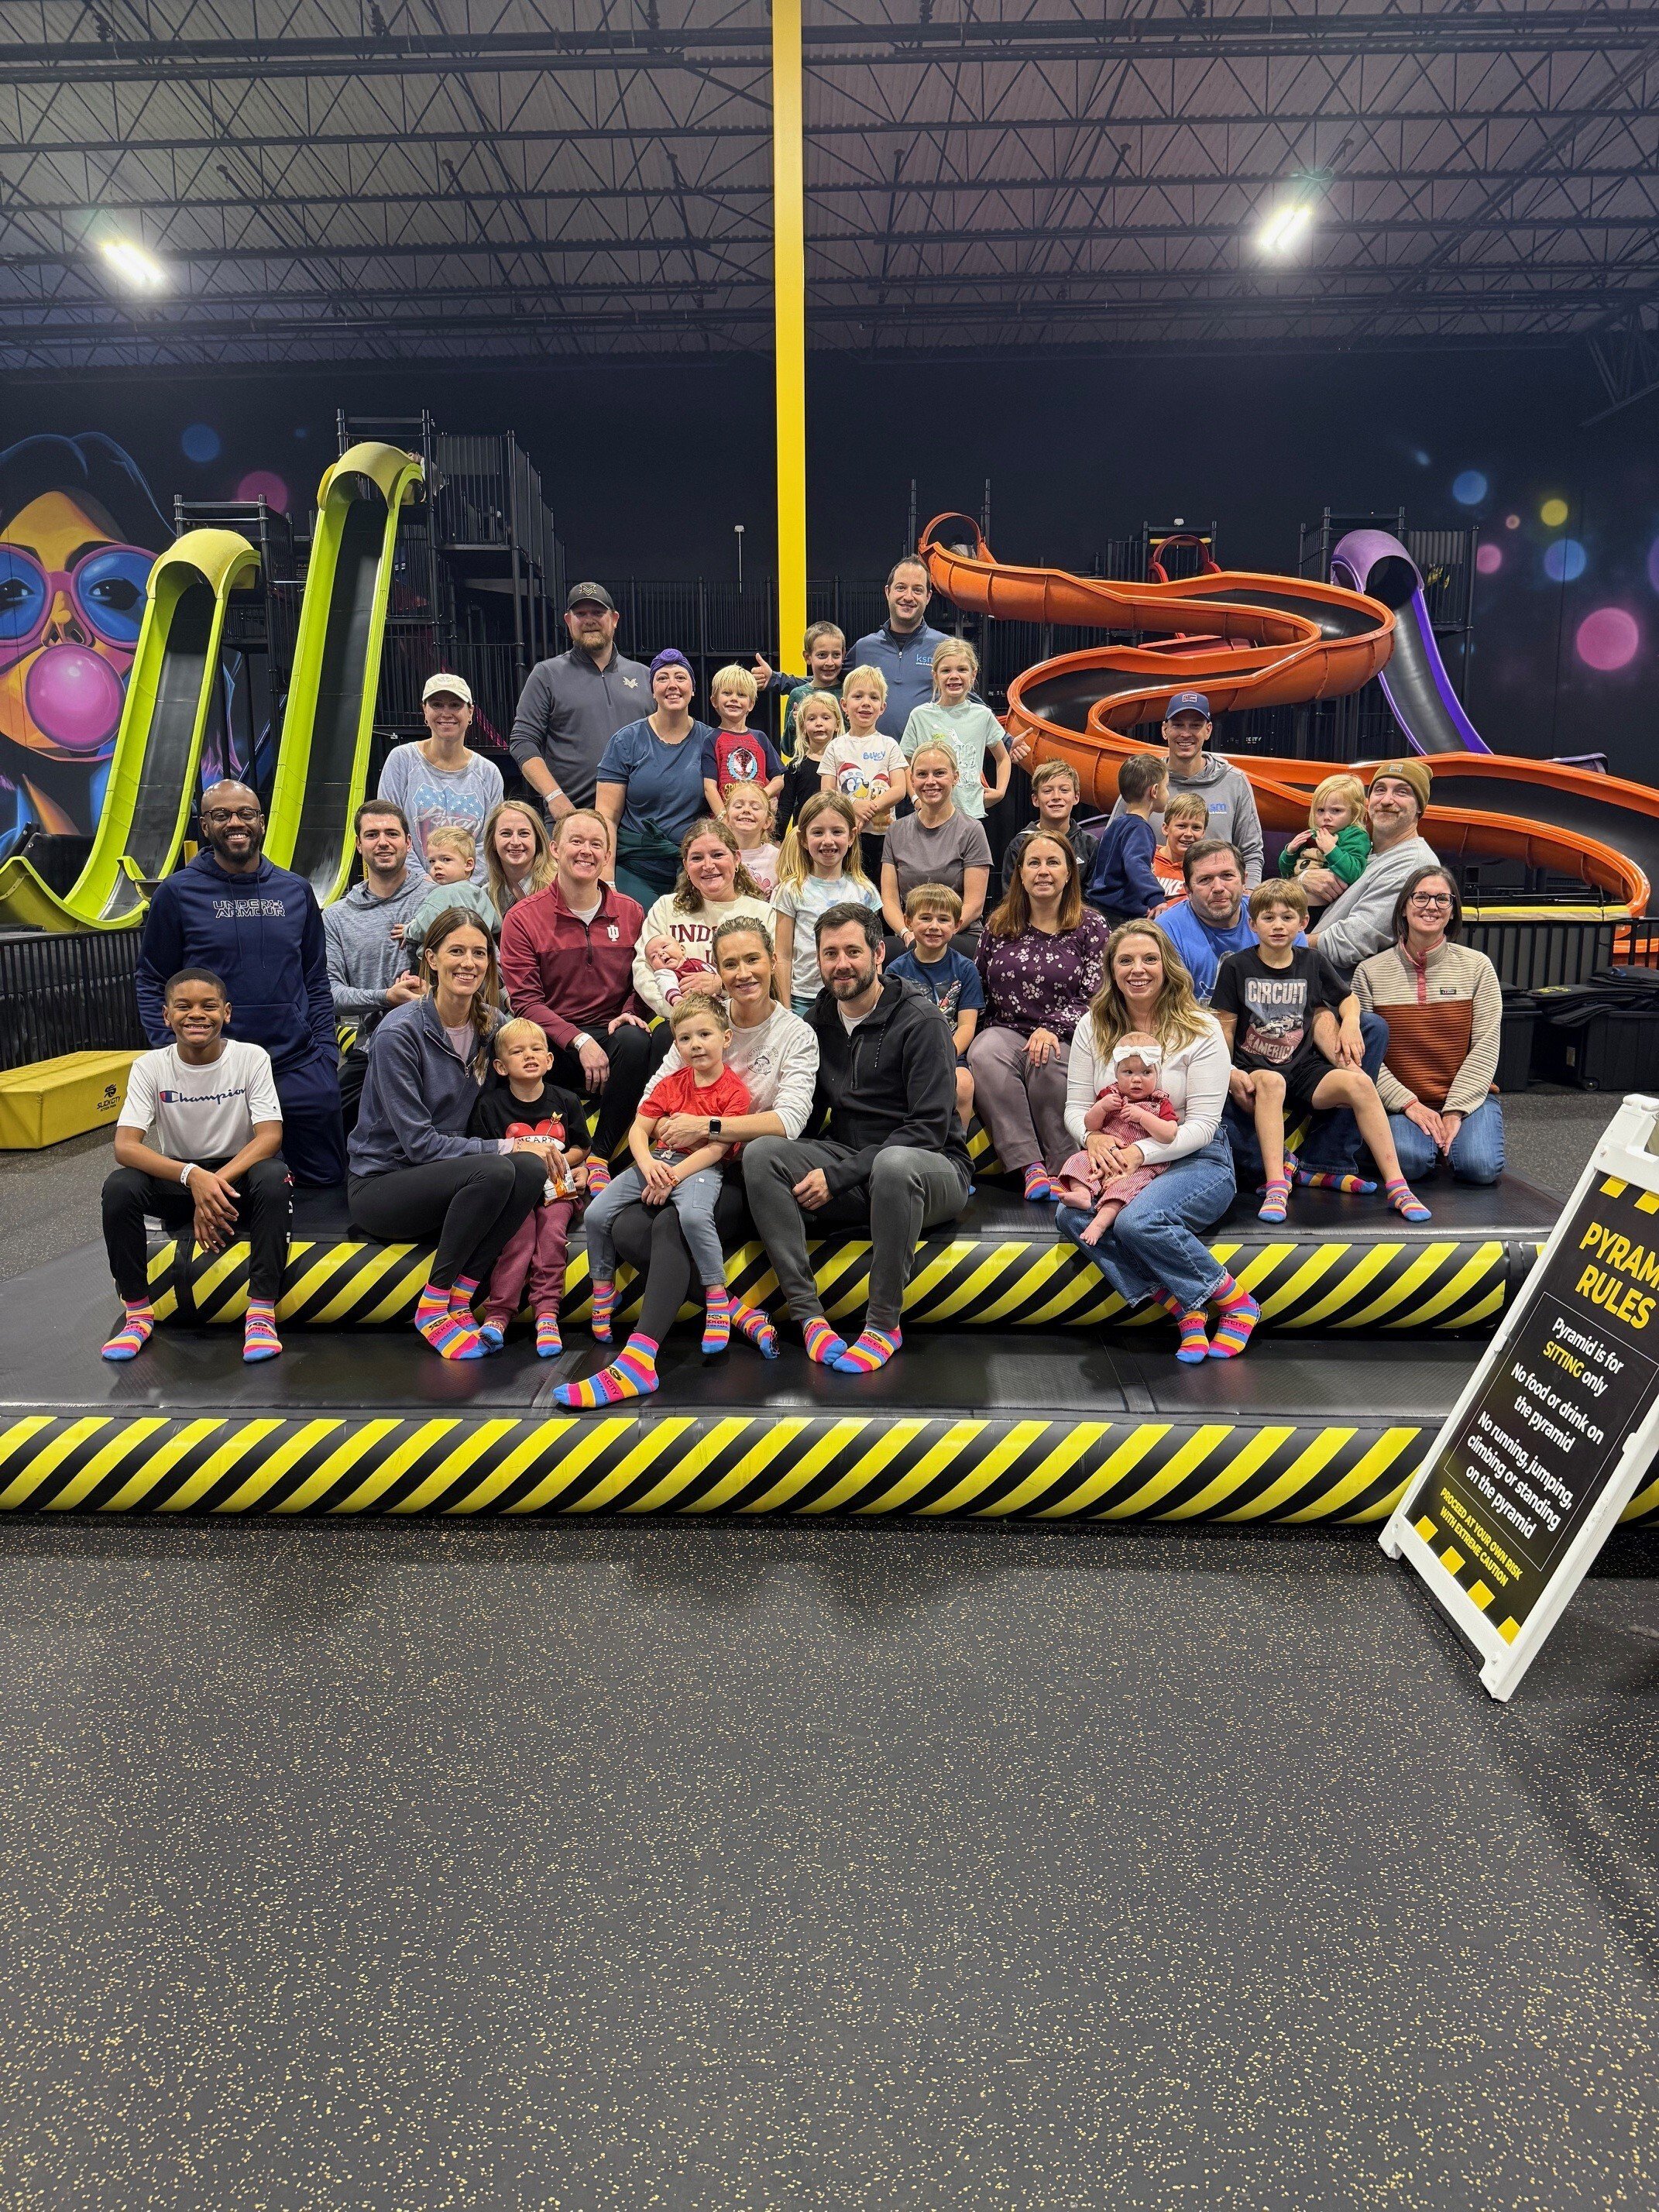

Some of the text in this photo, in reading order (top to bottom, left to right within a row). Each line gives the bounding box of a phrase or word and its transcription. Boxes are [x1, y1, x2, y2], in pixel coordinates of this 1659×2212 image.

[213, 899, 269, 909] UNDER
[216, 908, 285, 918] ARMOUR
[669, 924, 717, 943] IND
[1248, 981, 1306, 1005] CIRCUIT
[160, 1087, 246, 1104] Champion
[1578, 1221, 1659, 1291] PYRAM
[1575, 1264, 1657, 1329] RULES
[1543, 1341, 1608, 1397] SITTING only
[1552, 1317, 1624, 1374] Pyramid is for
[1511, 1362, 1604, 1445] No food or drink on
[1513, 1395, 1576, 1453] the pyramid
[1467, 1434, 1561, 1532] climbing or standing
[1477, 1411, 1573, 1510] No running, jumping,
[1465, 1466, 1537, 1539] on the pyramid
[1440, 1487, 1523, 1581] PROCEED AT YOUR OWN RISK
[1440, 1506, 1509, 1587] WITH EXTREME CAUTION
